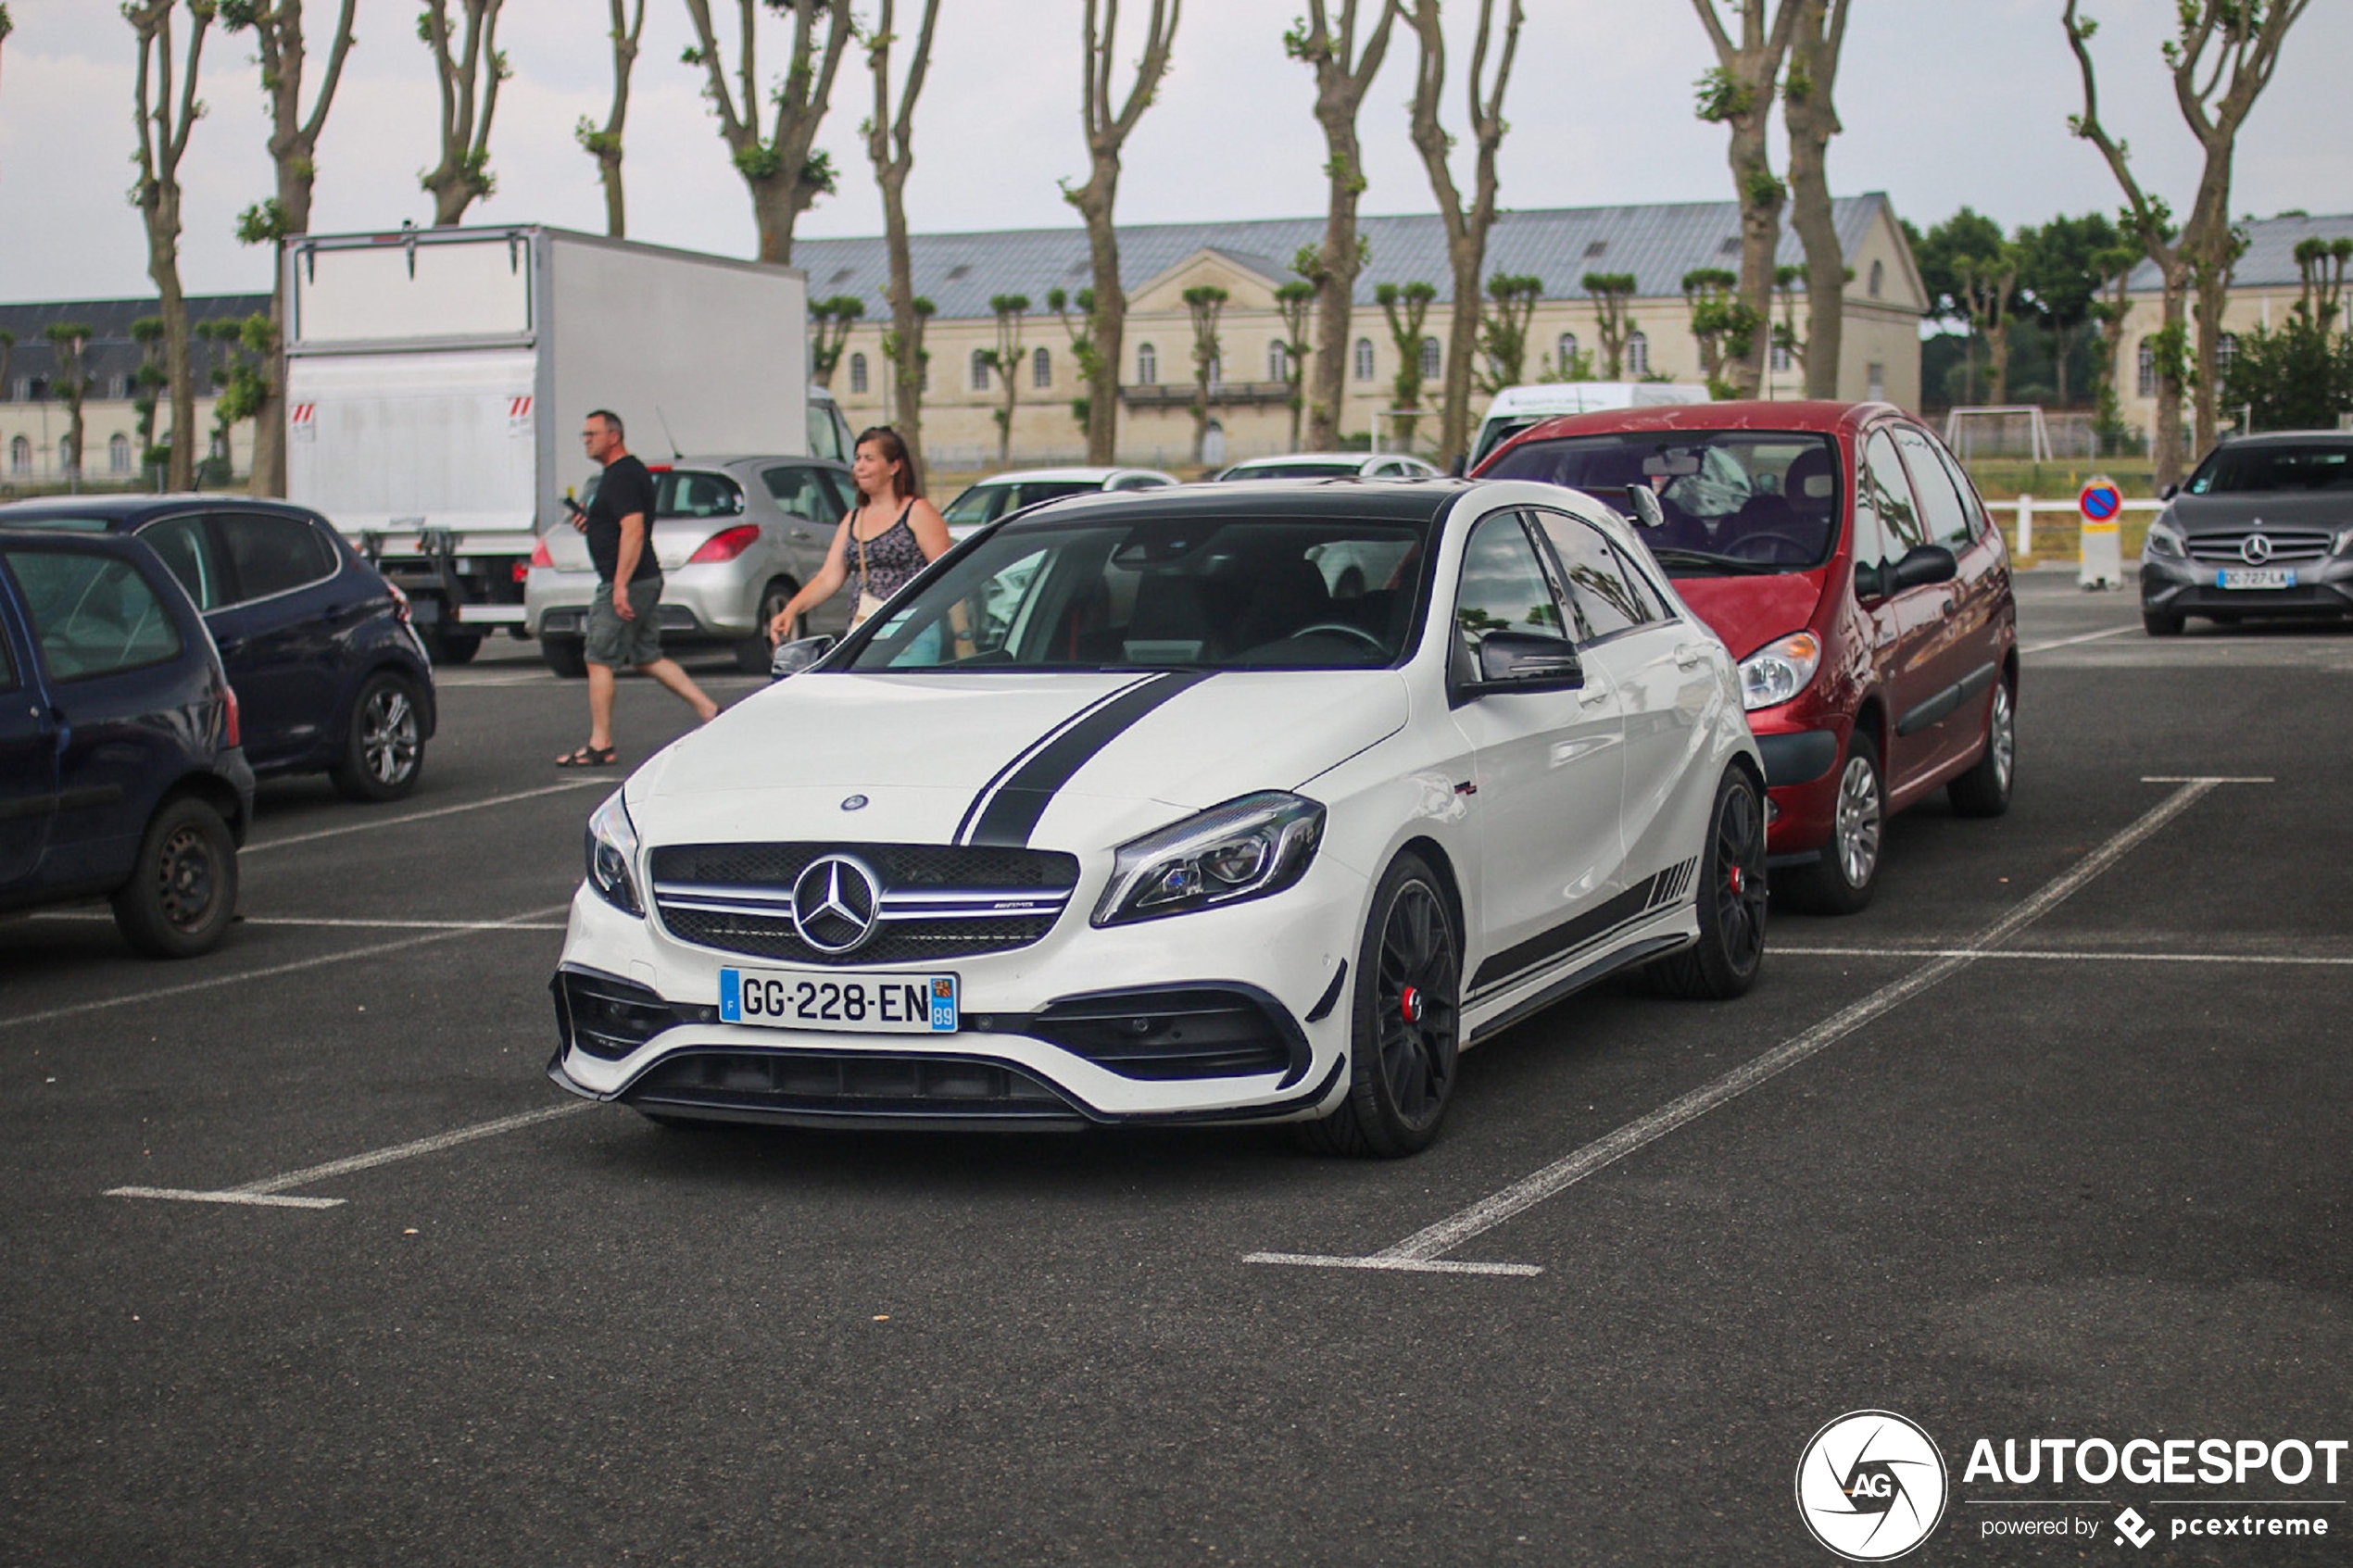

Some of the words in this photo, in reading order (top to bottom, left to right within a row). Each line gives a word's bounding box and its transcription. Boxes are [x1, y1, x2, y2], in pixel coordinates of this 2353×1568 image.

[727, 1000, 734, 1011] F
[743, 978, 929, 1022] GG-228-EN
[933, 1008, 953, 1025] 89
